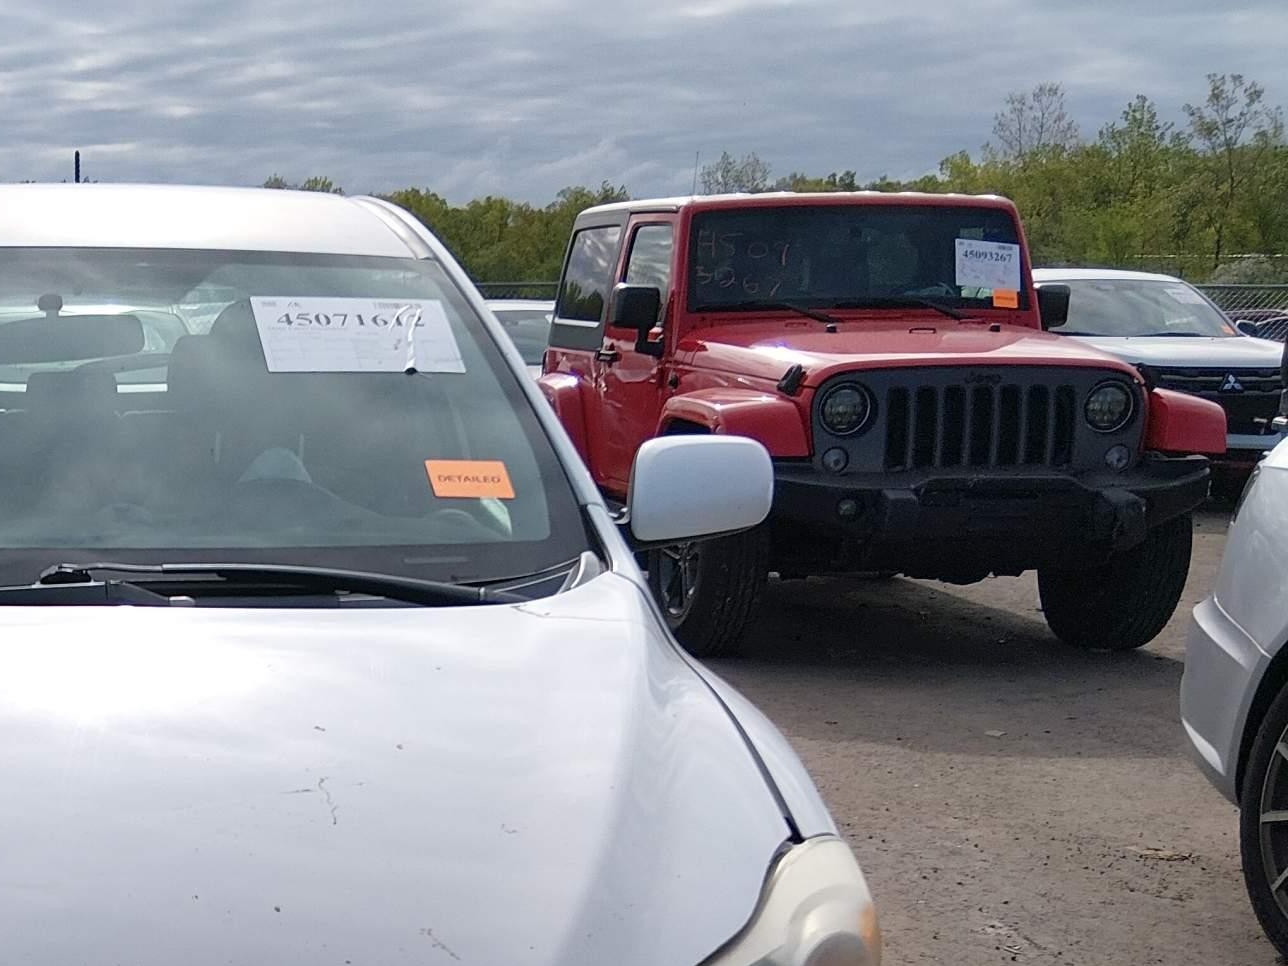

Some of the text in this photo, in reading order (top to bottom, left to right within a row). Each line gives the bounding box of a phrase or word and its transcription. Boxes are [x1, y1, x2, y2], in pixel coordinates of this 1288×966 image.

[962, 249, 1012, 262] 45093267
[277, 312, 425, 328] 45071612
[438, 474, 501, 483] DETAILED
